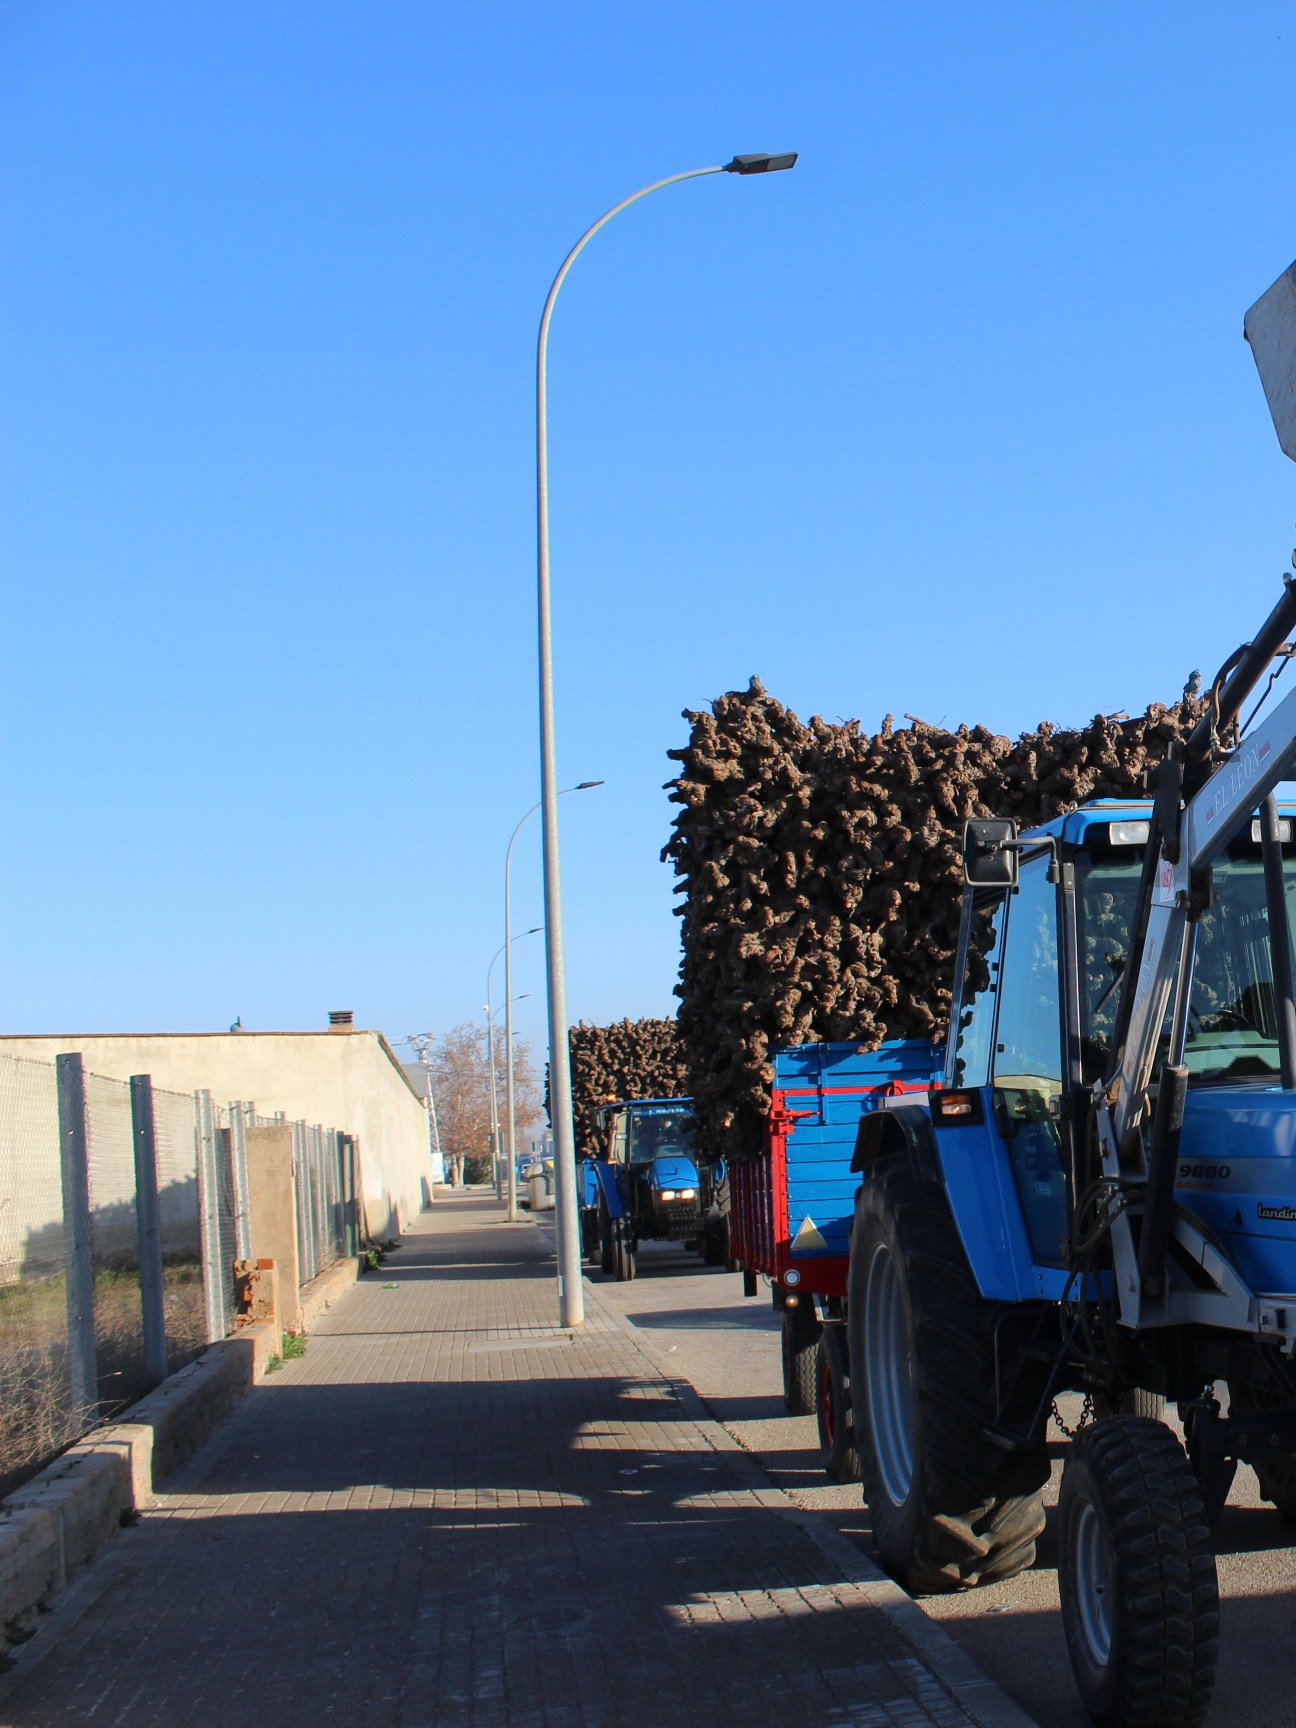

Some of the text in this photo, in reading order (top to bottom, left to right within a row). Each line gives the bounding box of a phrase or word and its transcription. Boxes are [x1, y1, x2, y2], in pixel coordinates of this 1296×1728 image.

[1214, 744, 1260, 817] EL LEON
[1179, 1164, 1232, 1180] 9880
